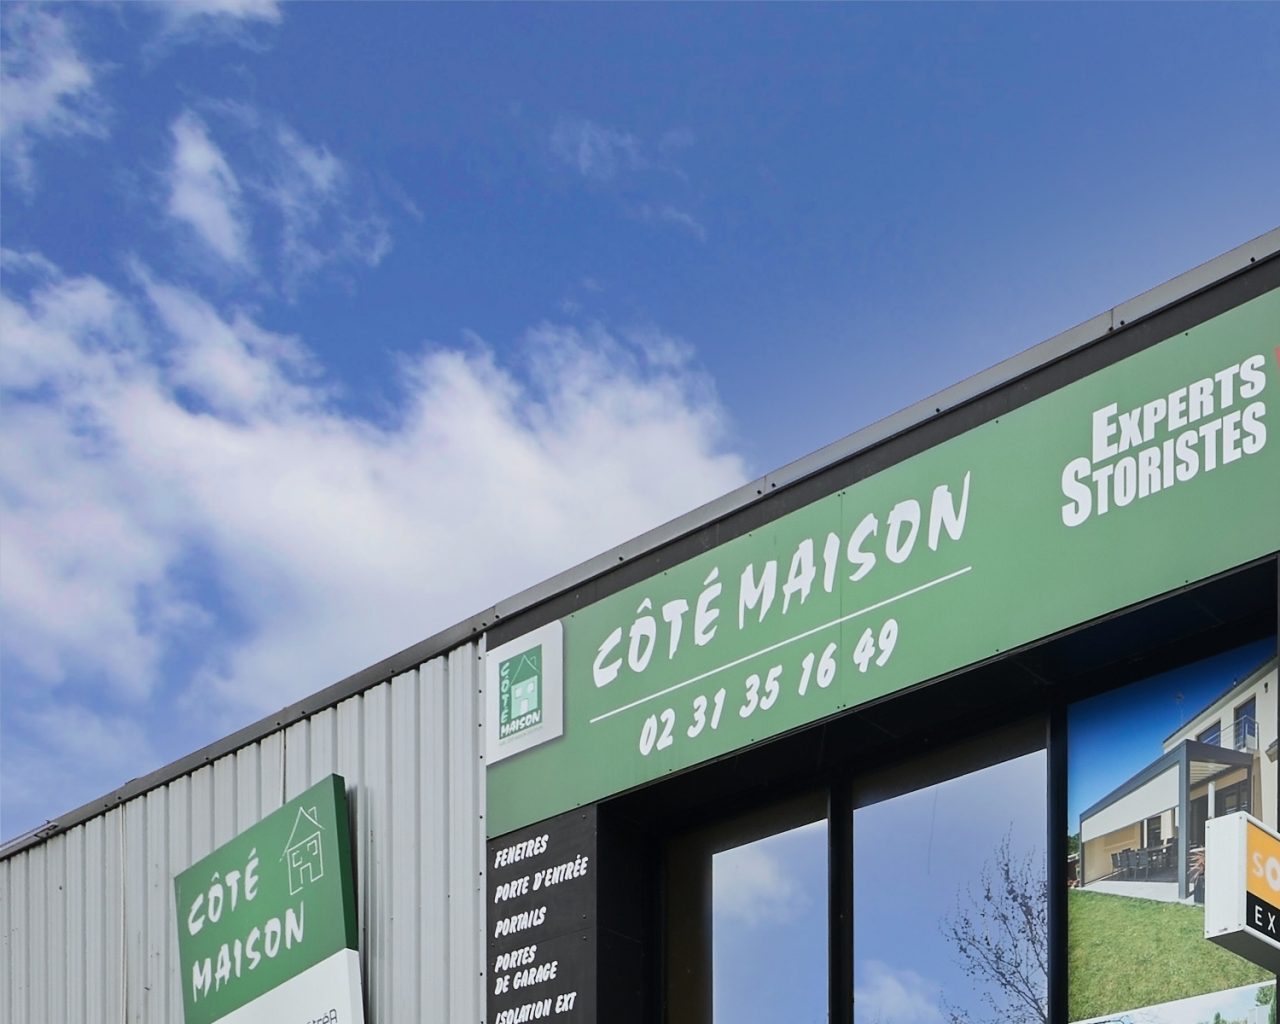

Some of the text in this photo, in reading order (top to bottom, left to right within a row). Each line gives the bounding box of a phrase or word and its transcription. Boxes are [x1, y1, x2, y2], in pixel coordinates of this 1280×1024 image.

[1092, 354, 1267, 463] EXPERTS
[1061, 401, 1267, 527] STORISTES
[592, 470, 971, 688] CÔTÉ MAISON
[639, 618, 899, 756] 02 31 35 16 49
[500, 709, 541, 738] MAISON
[187, 847, 260, 938] CÔTÉ
[494, 854, 589, 904] PORTE D'ENTRÉE
[192, 901, 305, 1004] MAISON
[494, 906, 547, 939] PORTAILS
[494, 944, 537, 973] PORTES
[494, 960, 558, 995] DE GARAGE
[555, 991, 577, 1016] EXT
